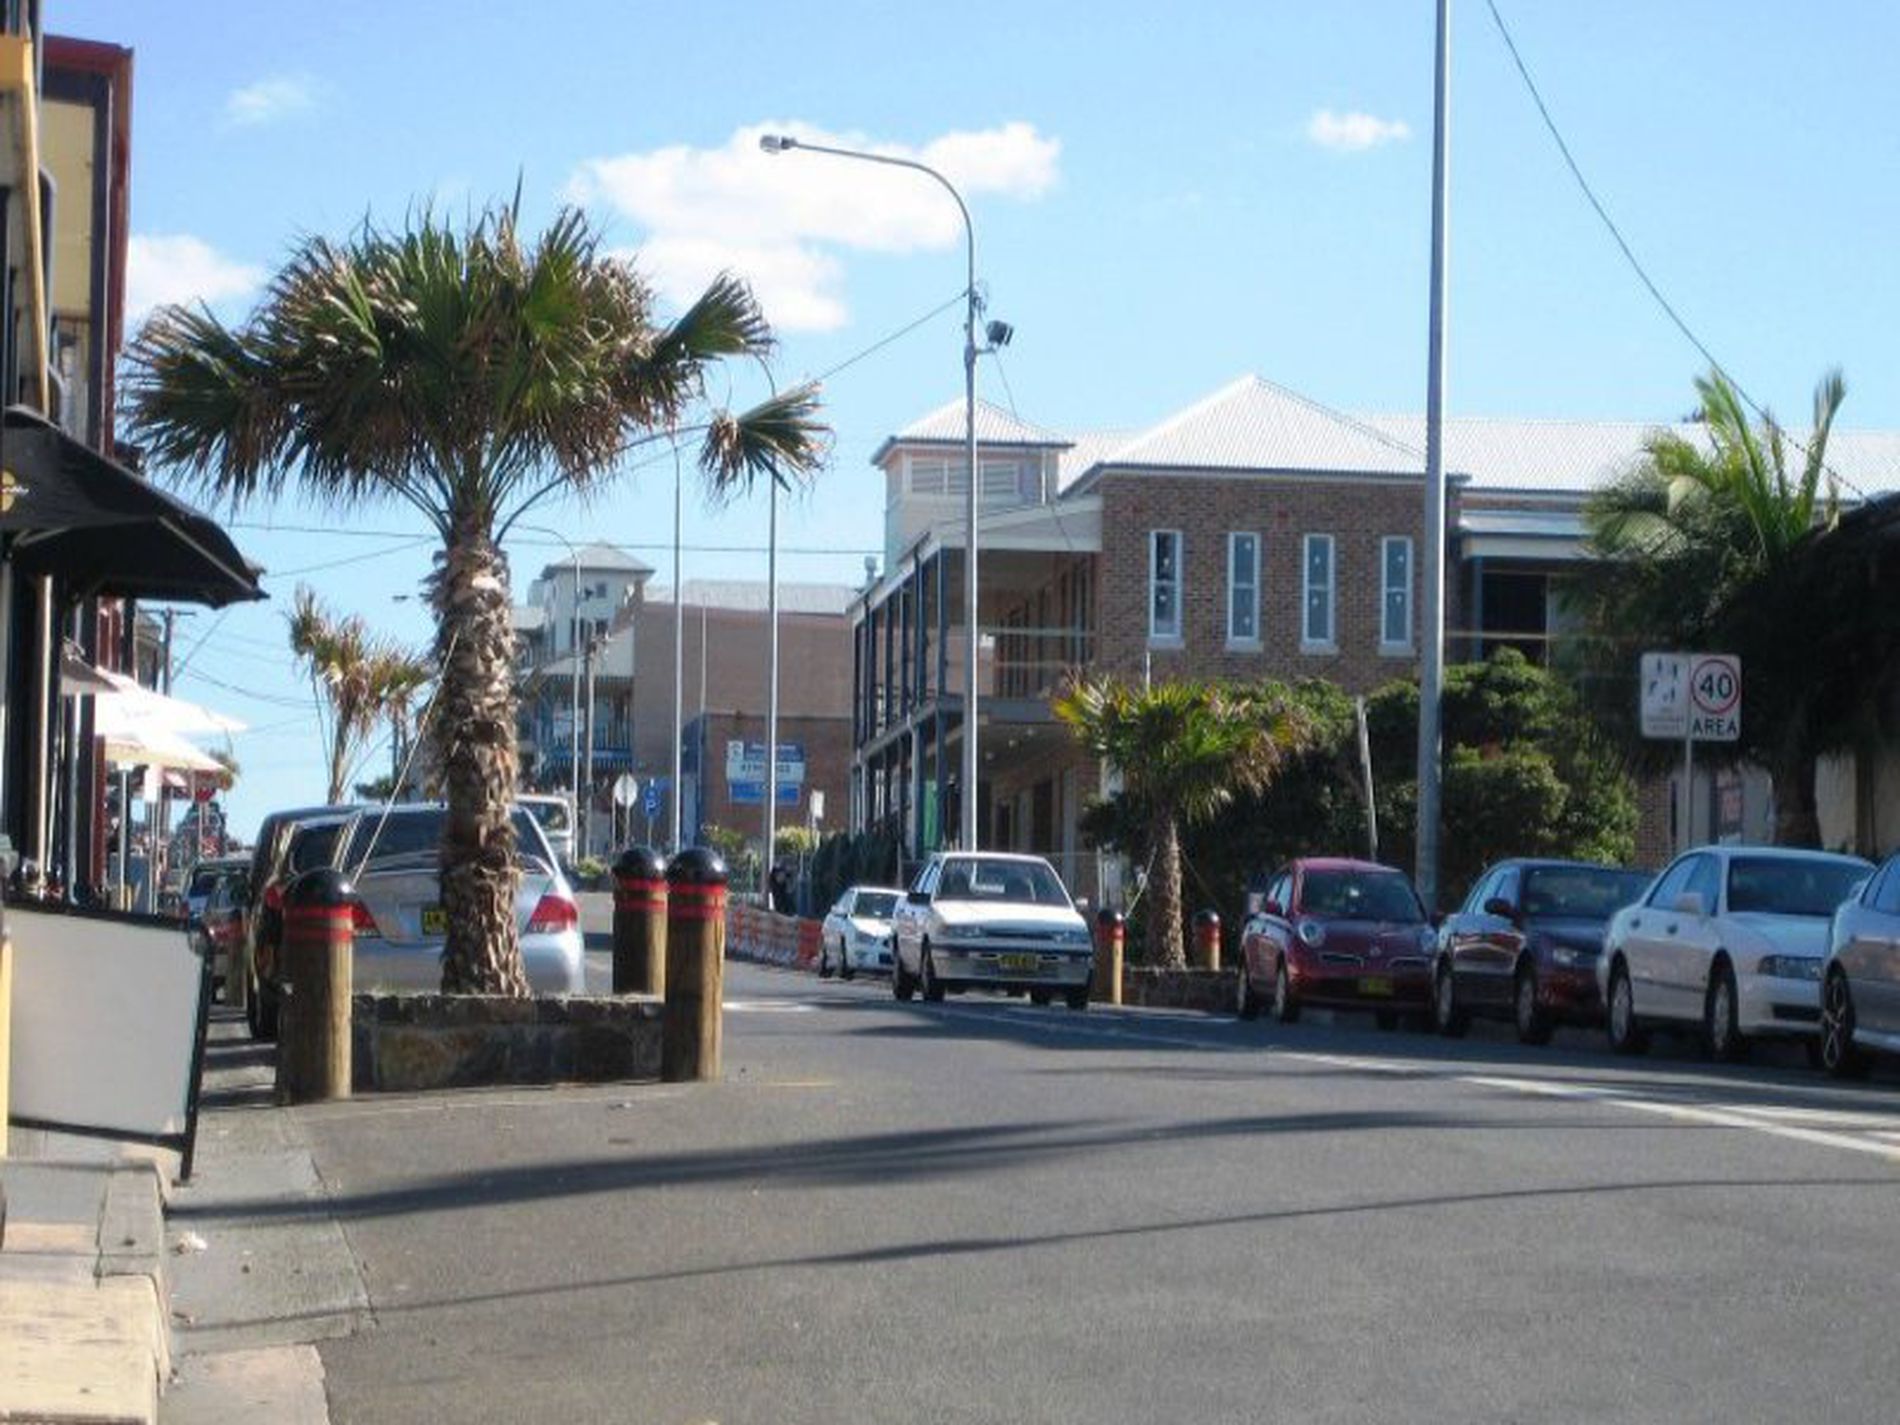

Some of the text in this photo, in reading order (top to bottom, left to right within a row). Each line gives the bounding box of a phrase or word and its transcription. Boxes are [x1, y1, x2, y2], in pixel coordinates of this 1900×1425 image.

[1700, 672, 1732, 699] 40
[1692, 717, 1738, 736] AREA
[645, 799, 657, 814] P
